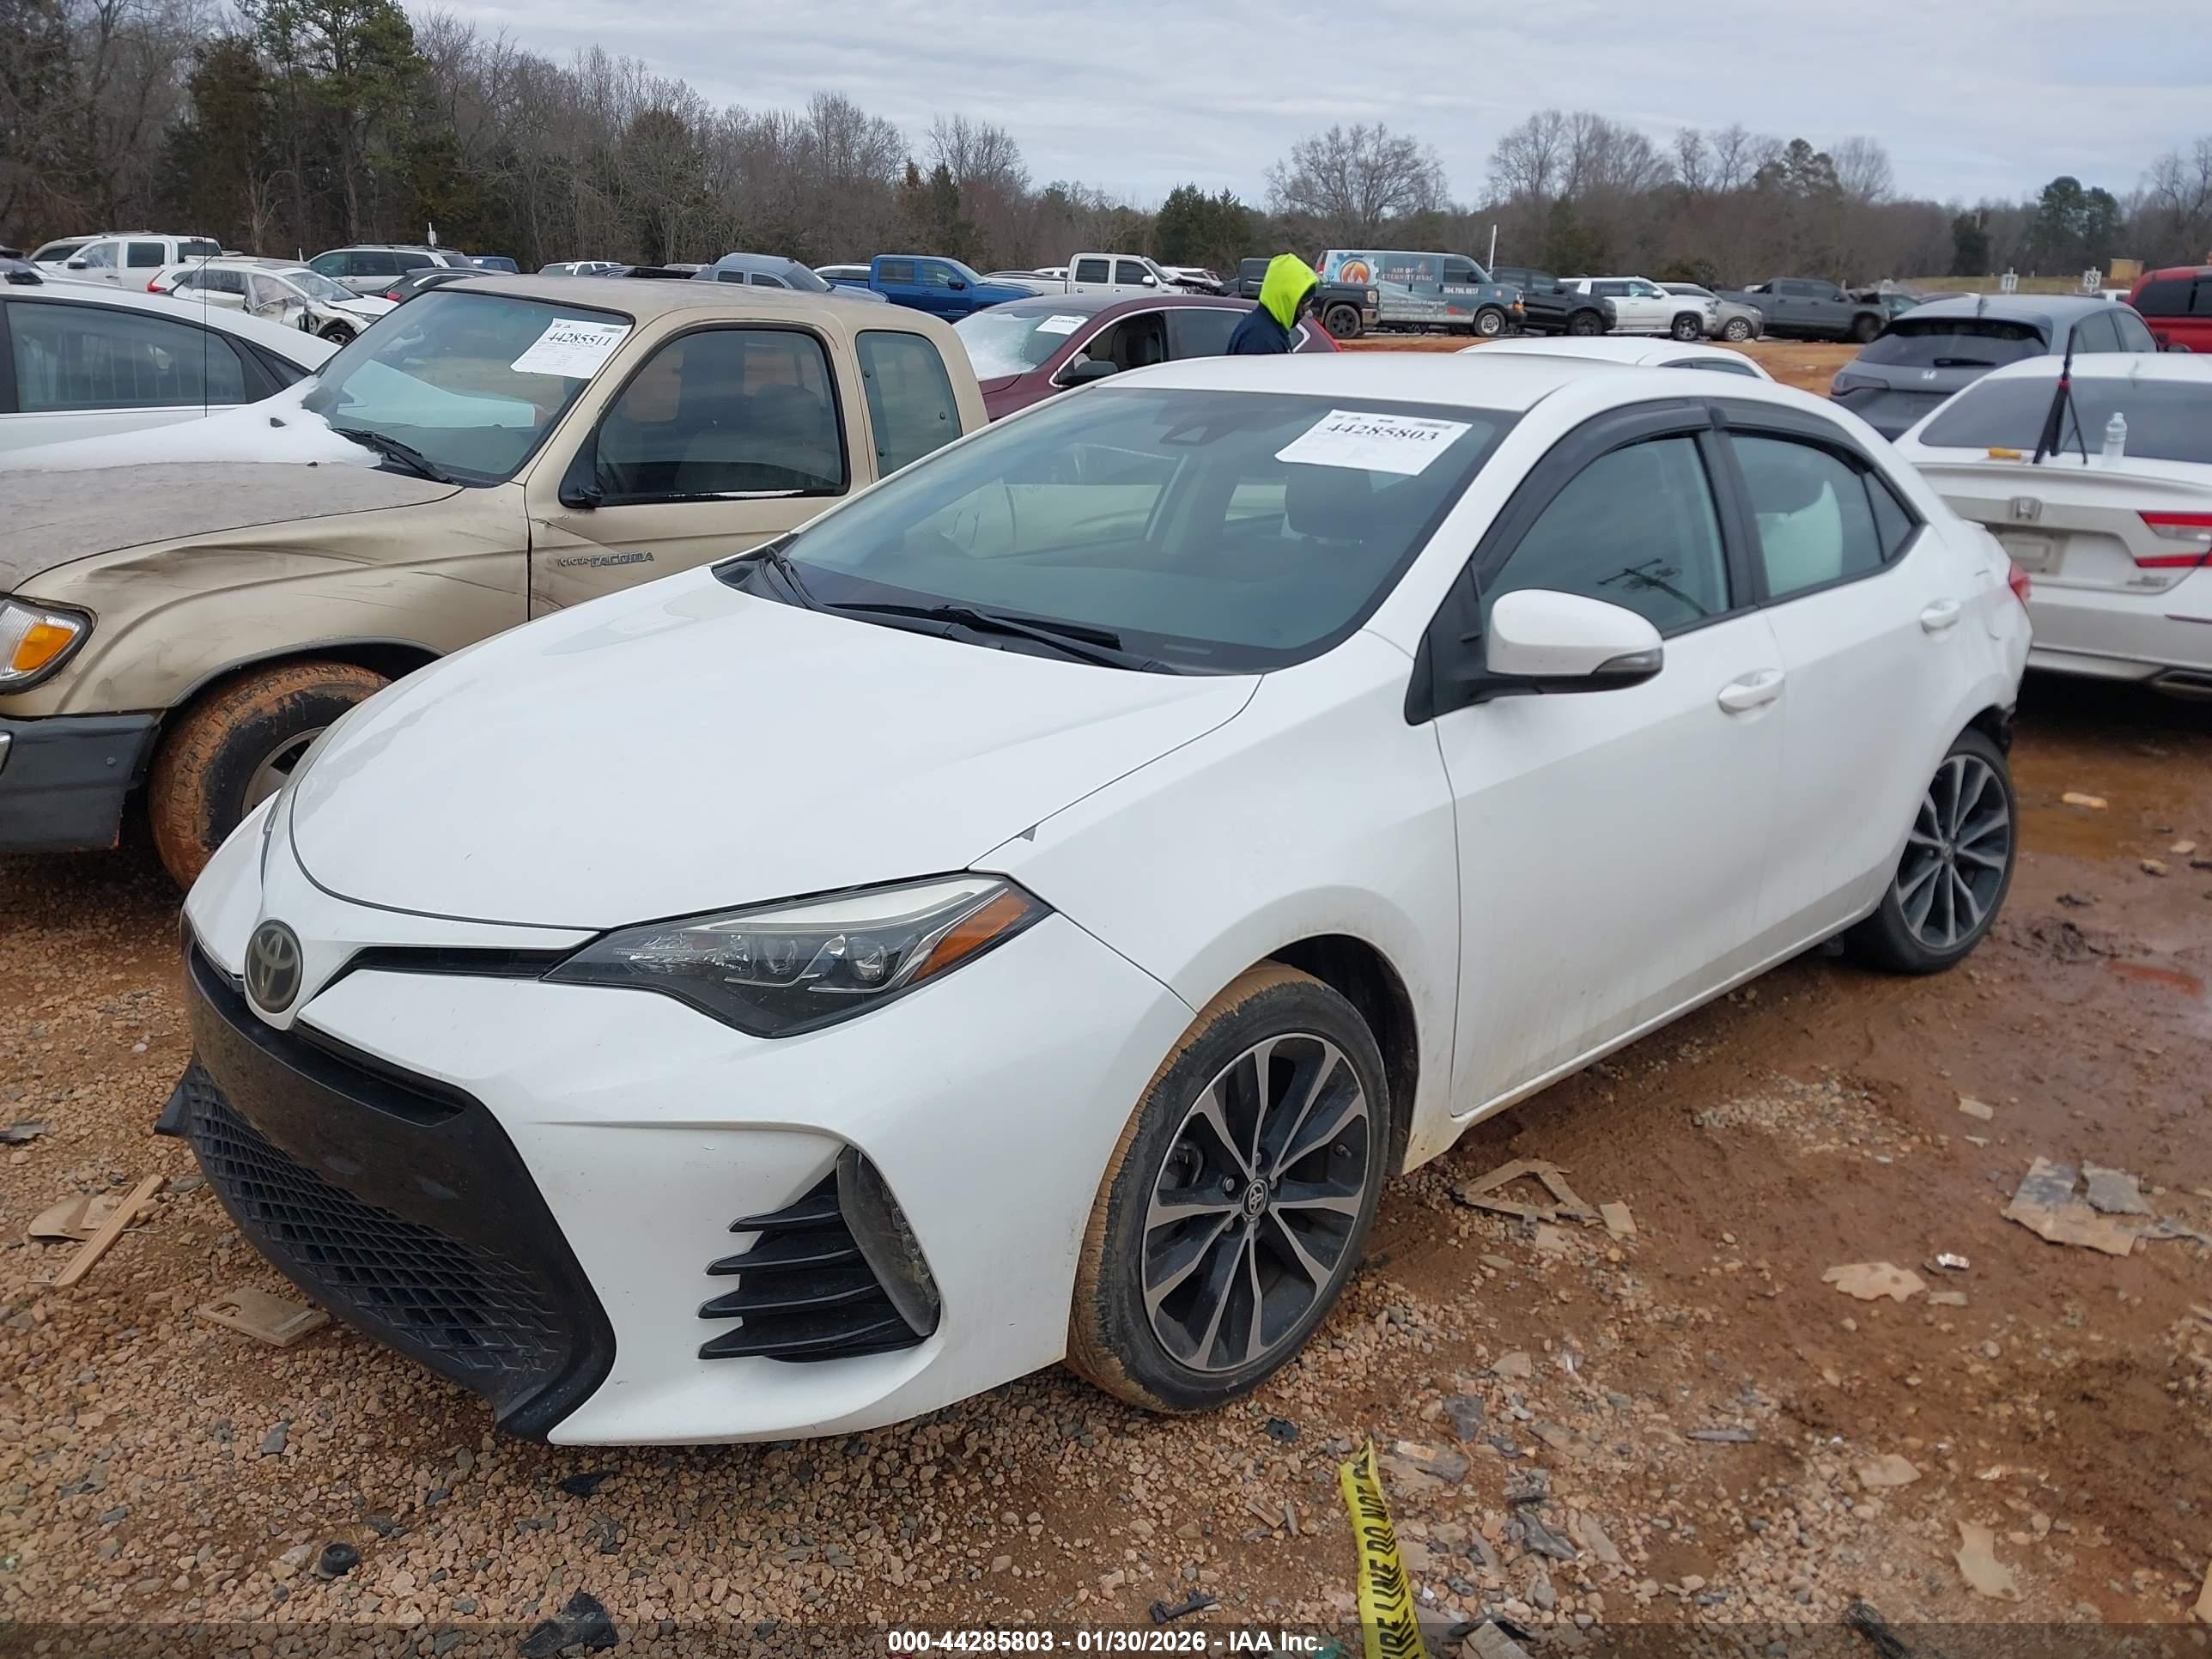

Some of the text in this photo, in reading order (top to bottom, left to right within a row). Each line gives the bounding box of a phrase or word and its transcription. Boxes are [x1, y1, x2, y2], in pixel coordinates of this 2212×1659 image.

[548, 331, 613, 347] 44285511
[1326, 422, 1440, 441] 44285803
[589, 550, 654, 568] TACOMA
[1355, 1484, 1389, 1523] NOT
[1363, 1527, 1396, 1557] DO
[1376, 1607, 1421, 1659] IRE
